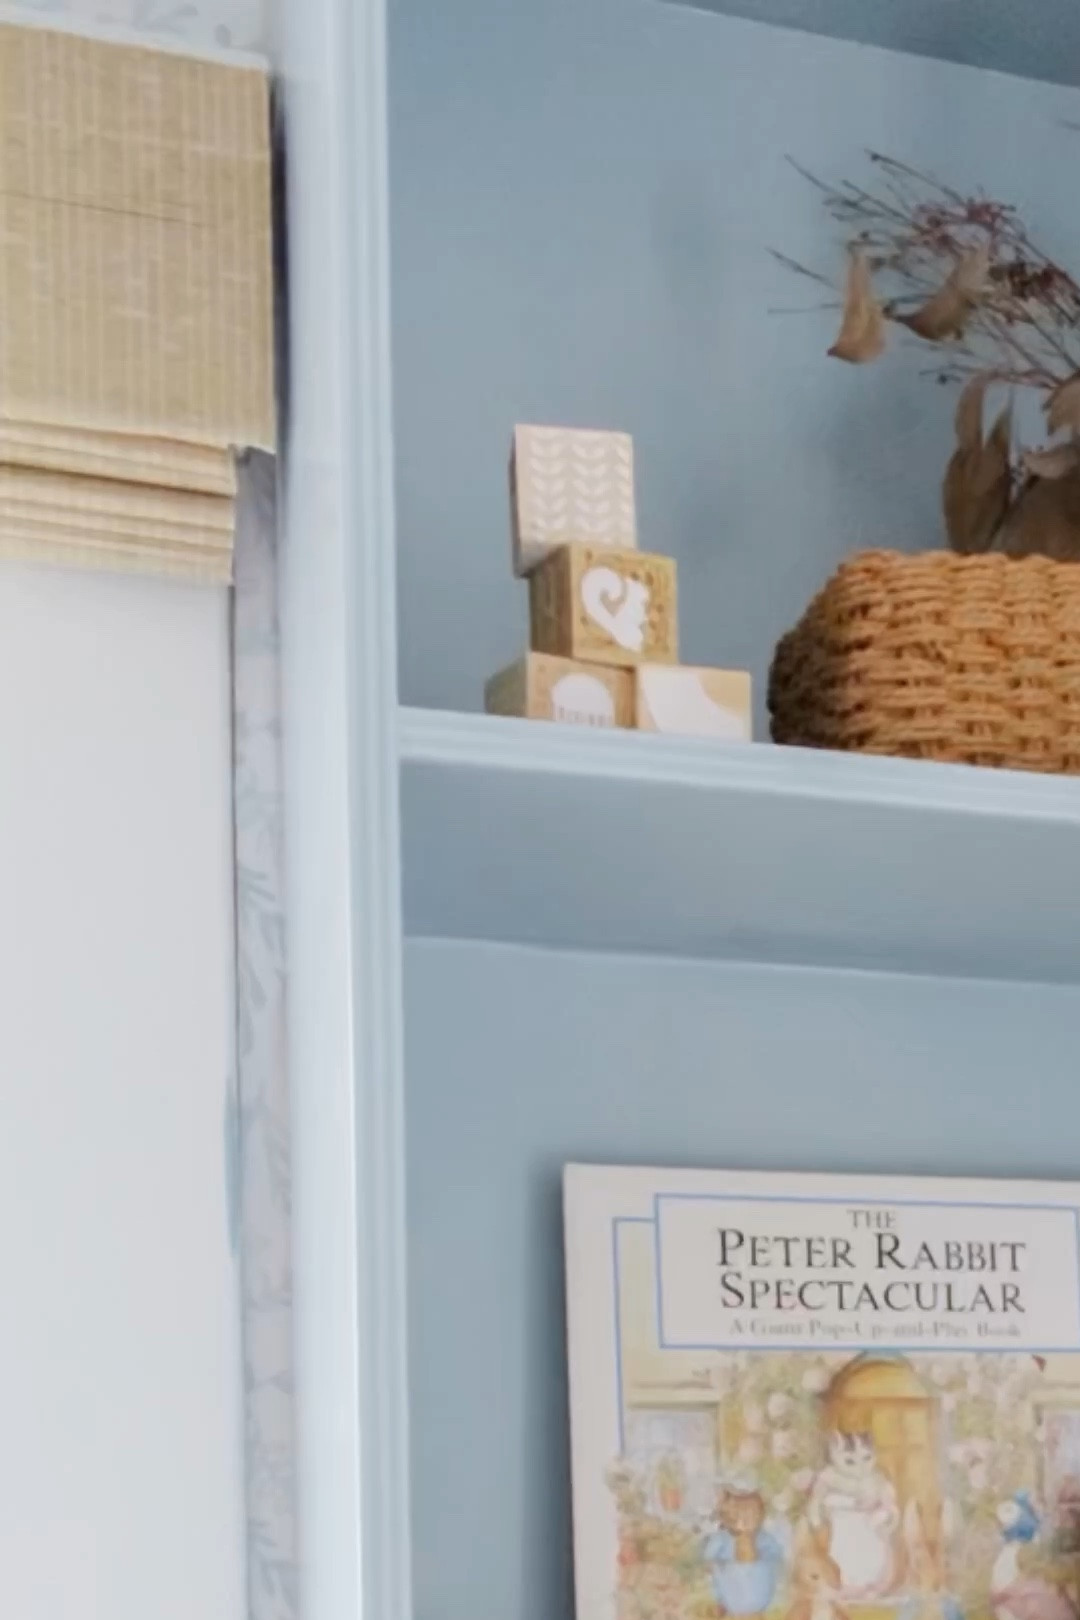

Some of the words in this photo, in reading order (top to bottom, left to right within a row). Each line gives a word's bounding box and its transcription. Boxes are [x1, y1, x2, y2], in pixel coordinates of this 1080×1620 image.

[847, 1209, 897, 1229] THE
[717, 1228, 856, 1268] PETER
[874, 1232, 1027, 1273] RABBIT
[720, 1271, 1026, 1314] SPECTACULAR
